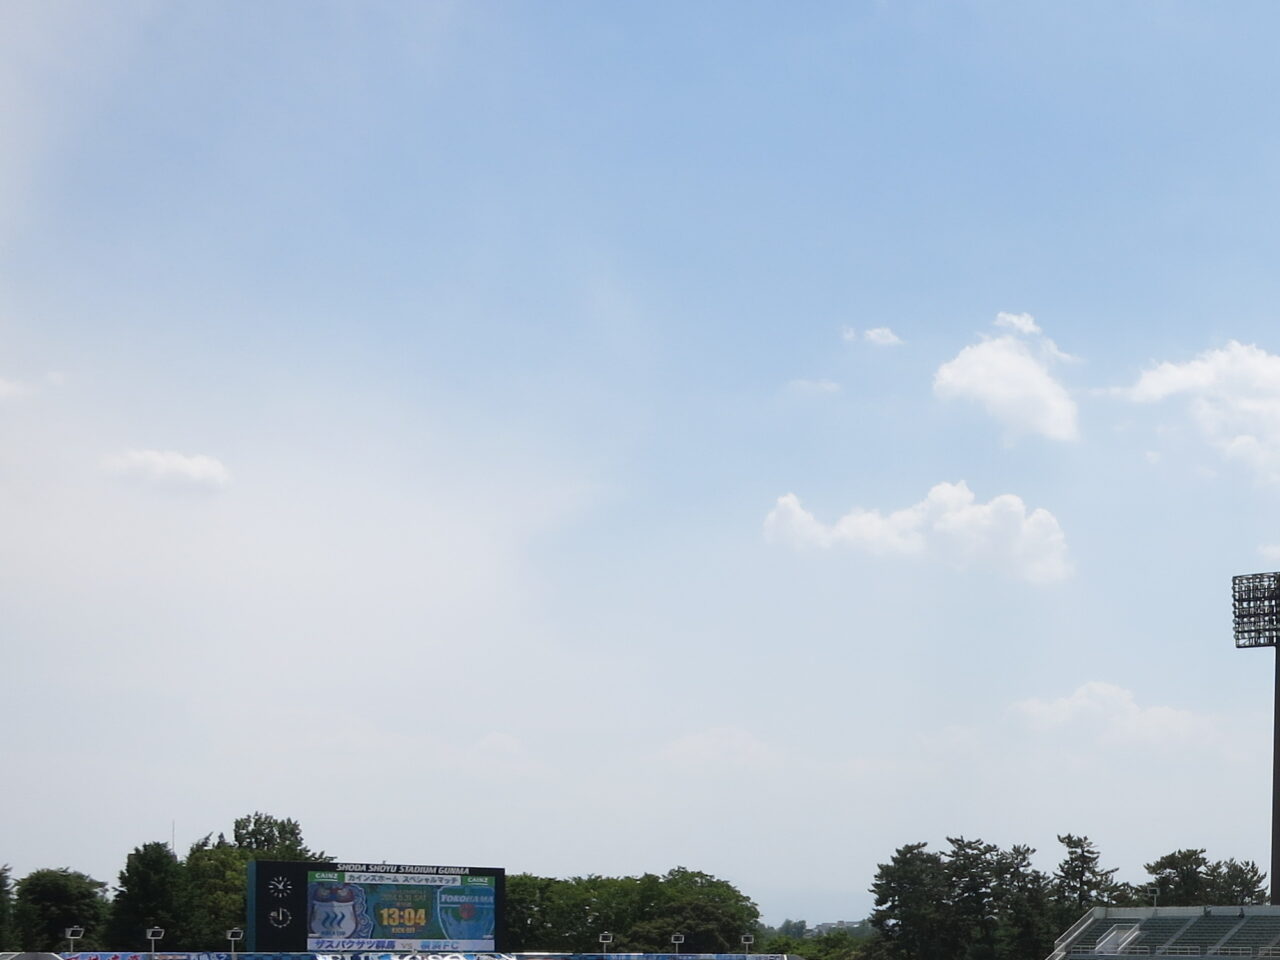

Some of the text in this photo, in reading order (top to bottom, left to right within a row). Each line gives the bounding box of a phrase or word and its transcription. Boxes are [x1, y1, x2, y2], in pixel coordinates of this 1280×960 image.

[336, 863, 470, 875] SHODA SHOYU STADIUM GUNMA
[441, 894, 494, 903] YOKOHAMA
[380, 907, 427, 926] 13:04
[314, 940, 396, 950] ザスパクサツ群馬
